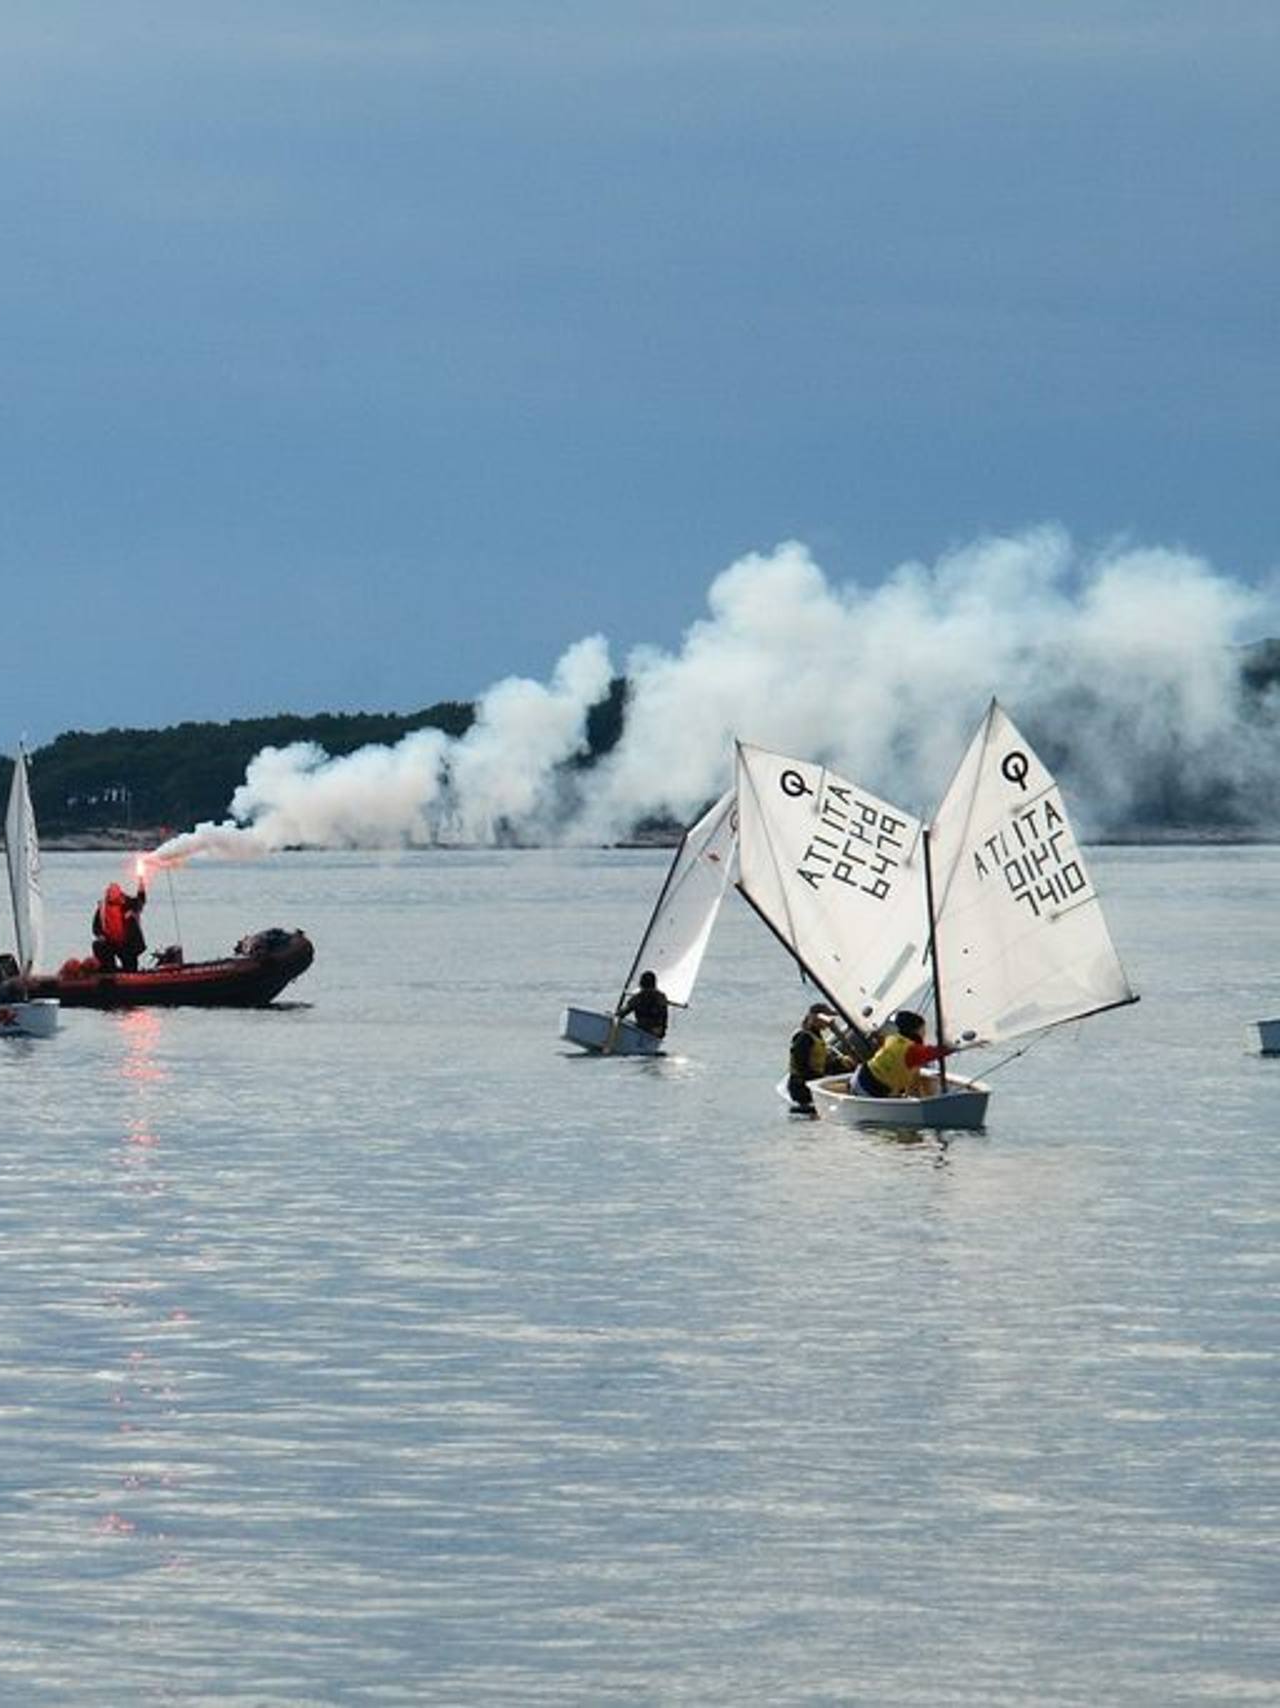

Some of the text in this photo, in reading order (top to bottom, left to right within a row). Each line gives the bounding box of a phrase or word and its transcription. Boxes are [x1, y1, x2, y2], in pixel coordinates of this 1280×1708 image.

[821, 785, 852, 833] ITA
[1012, 800, 1064, 848] ITA
[860, 815, 907, 900] 6479
[1015, 861, 1086, 916] 7410
